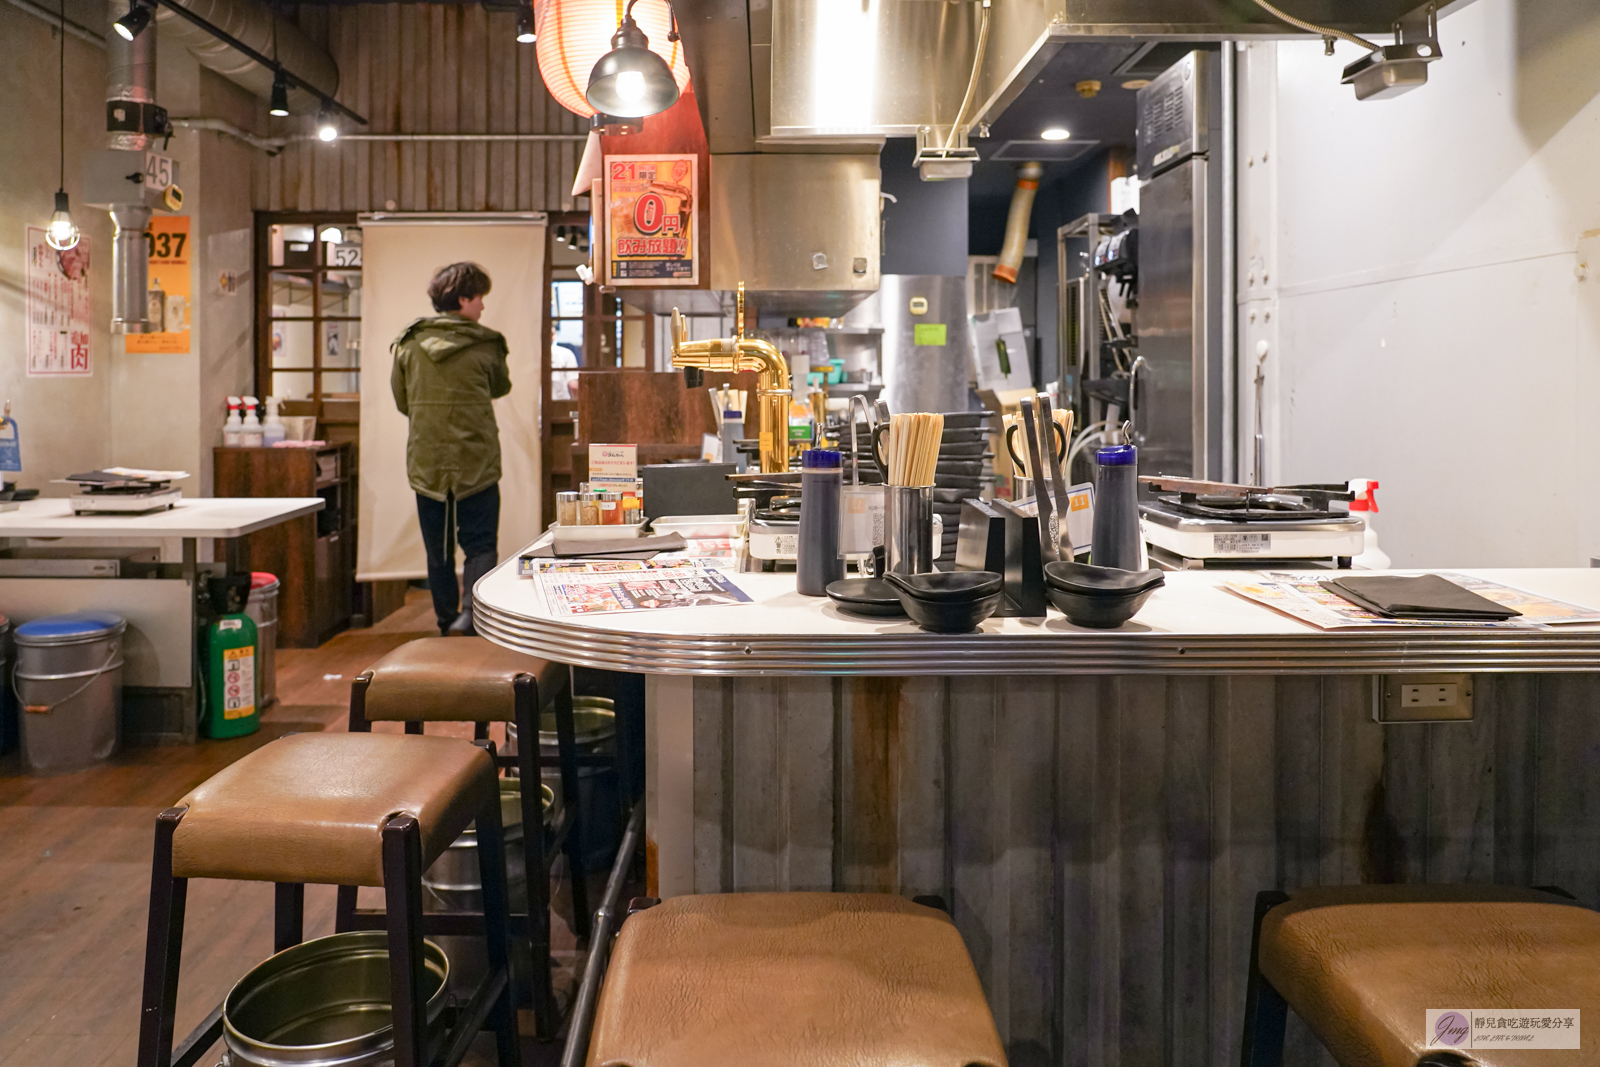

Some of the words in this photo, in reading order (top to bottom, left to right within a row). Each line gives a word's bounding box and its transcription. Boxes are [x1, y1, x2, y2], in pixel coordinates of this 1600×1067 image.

[145, 155, 170, 187] 45
[611, 162, 636, 180] 21
[336, 249, 360, 266] 52
[71, 343, 88, 369] 肉
[1073, 496, 1086, 507] 11
